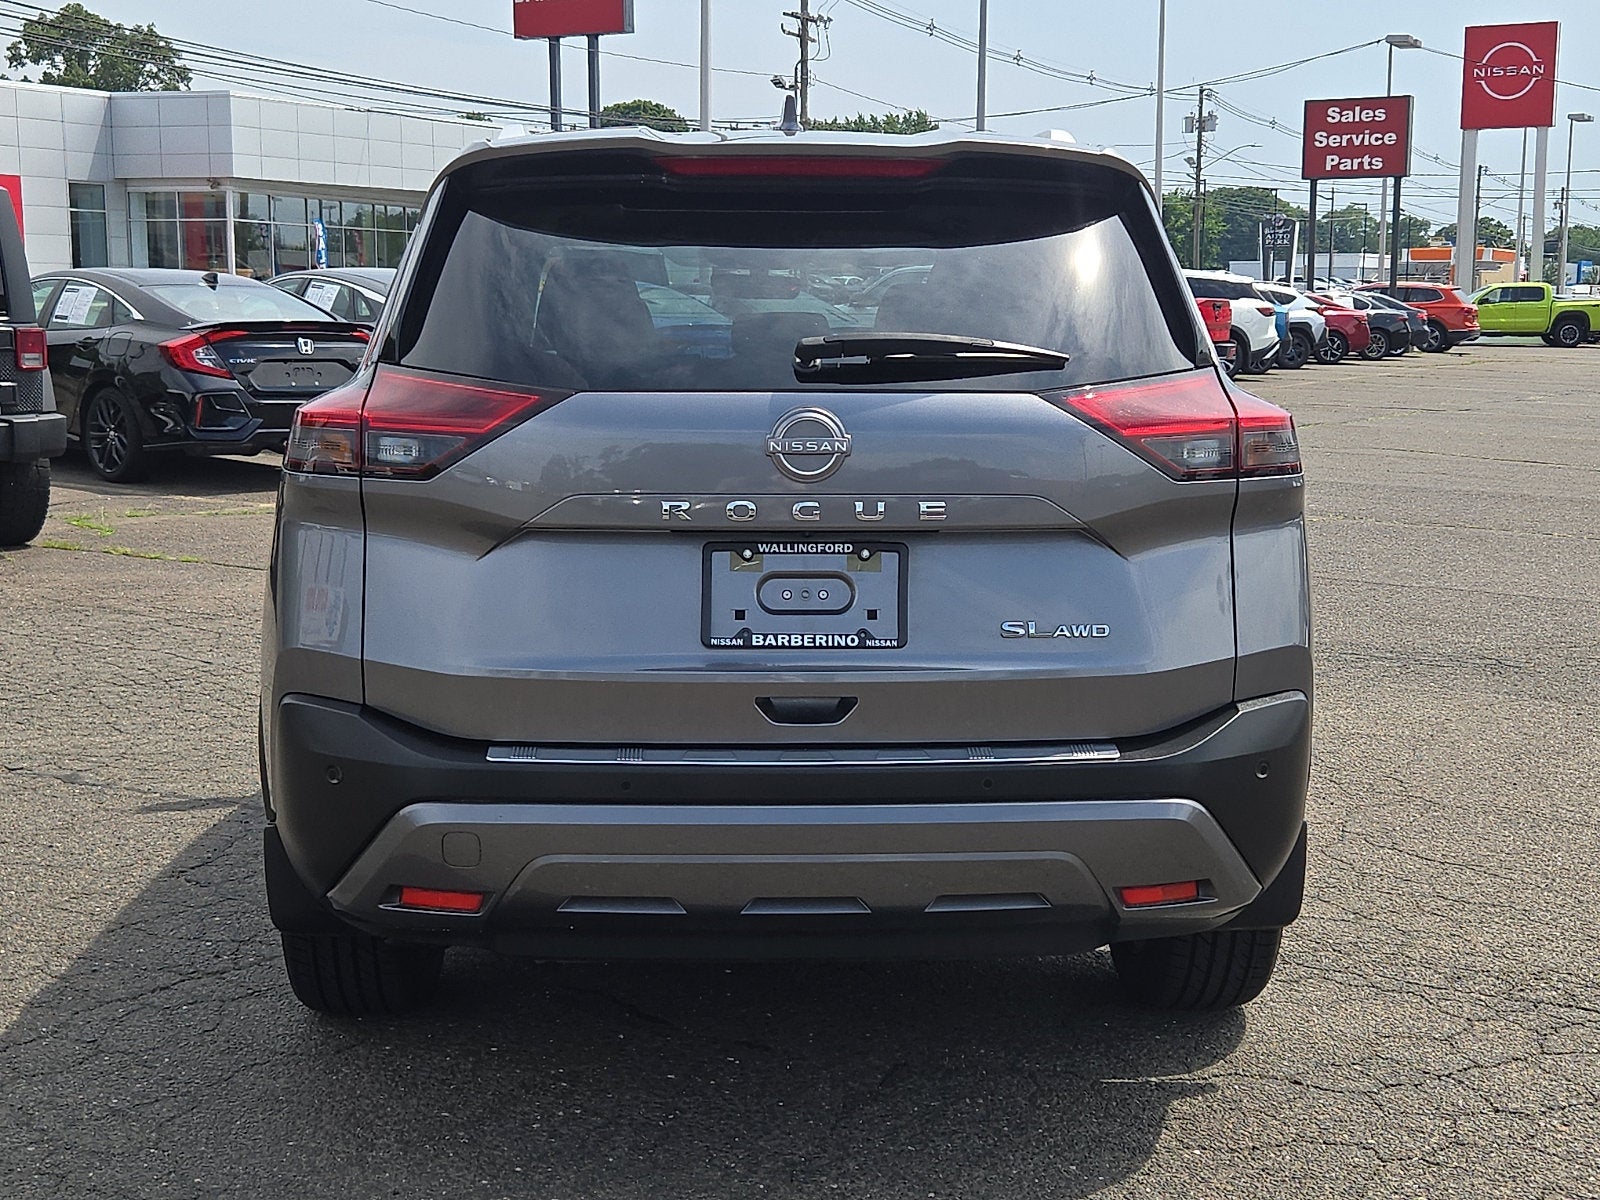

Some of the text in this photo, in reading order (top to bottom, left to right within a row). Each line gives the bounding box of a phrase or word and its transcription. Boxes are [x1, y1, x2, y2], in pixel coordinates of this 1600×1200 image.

[1473, 64, 1545, 78] NISSAN
[1326, 105, 1387, 123] Sales
[1313, 129, 1398, 148] Service
[1325, 153, 1384, 171] Parts
[769, 439, 848, 453] NISSAN
[660, 500, 948, 522] ROGUE
[757, 543, 854, 554] WALLINGFORD
[1052, 623, 1111, 639] AWD
[710, 634, 898, 648] NISSAN BARBERINO NISSAN
